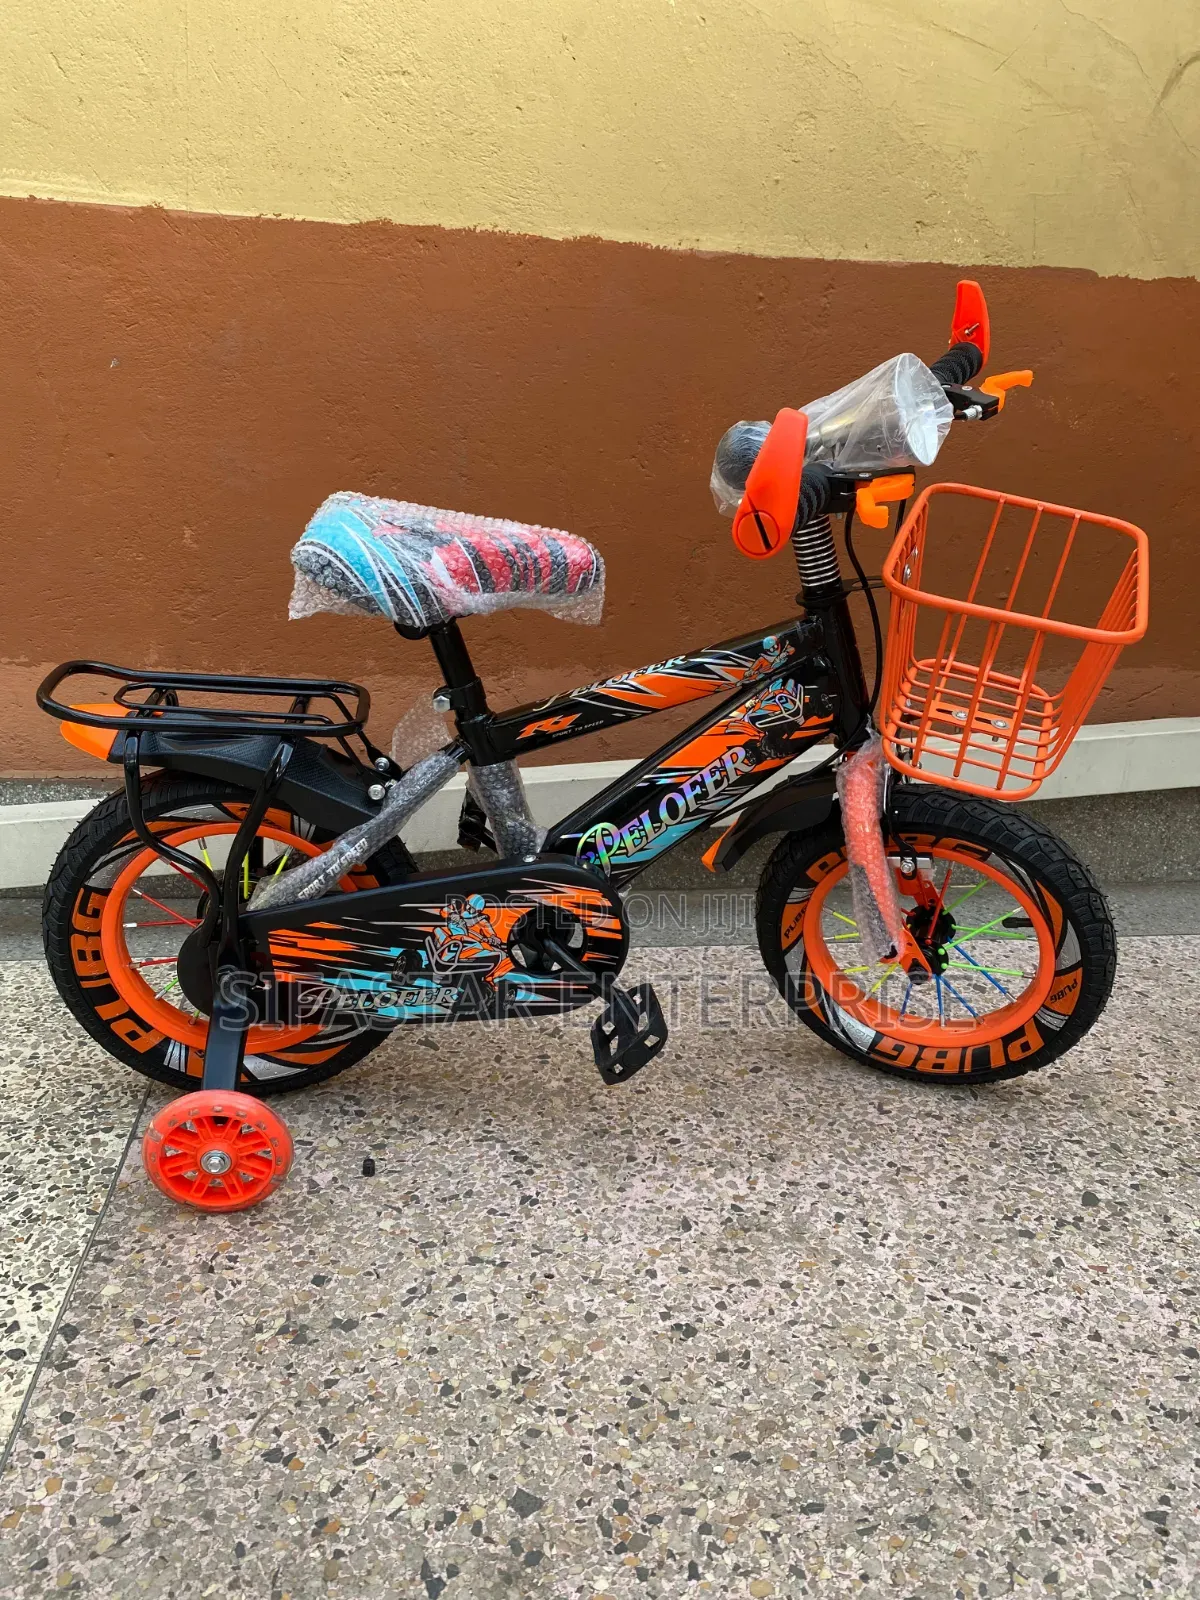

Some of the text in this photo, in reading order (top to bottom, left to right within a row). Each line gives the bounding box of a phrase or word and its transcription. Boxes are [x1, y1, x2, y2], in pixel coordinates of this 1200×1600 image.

[552, 729, 572, 738] SPORT
[584, 720, 604, 729] SPEED
[576, 747, 756, 877] PELOFER
[298, 874, 326, 899] SPORT
[340, 838, 369, 864] SPEED
[806, 833, 990, 883] PBG
[71, 887, 168, 1053] PUBG
[1050, 977, 1078, 1004] PUBG
[295, 986, 457, 1018] PELOFER
[869, 1017, 1045, 1074] PUBG
